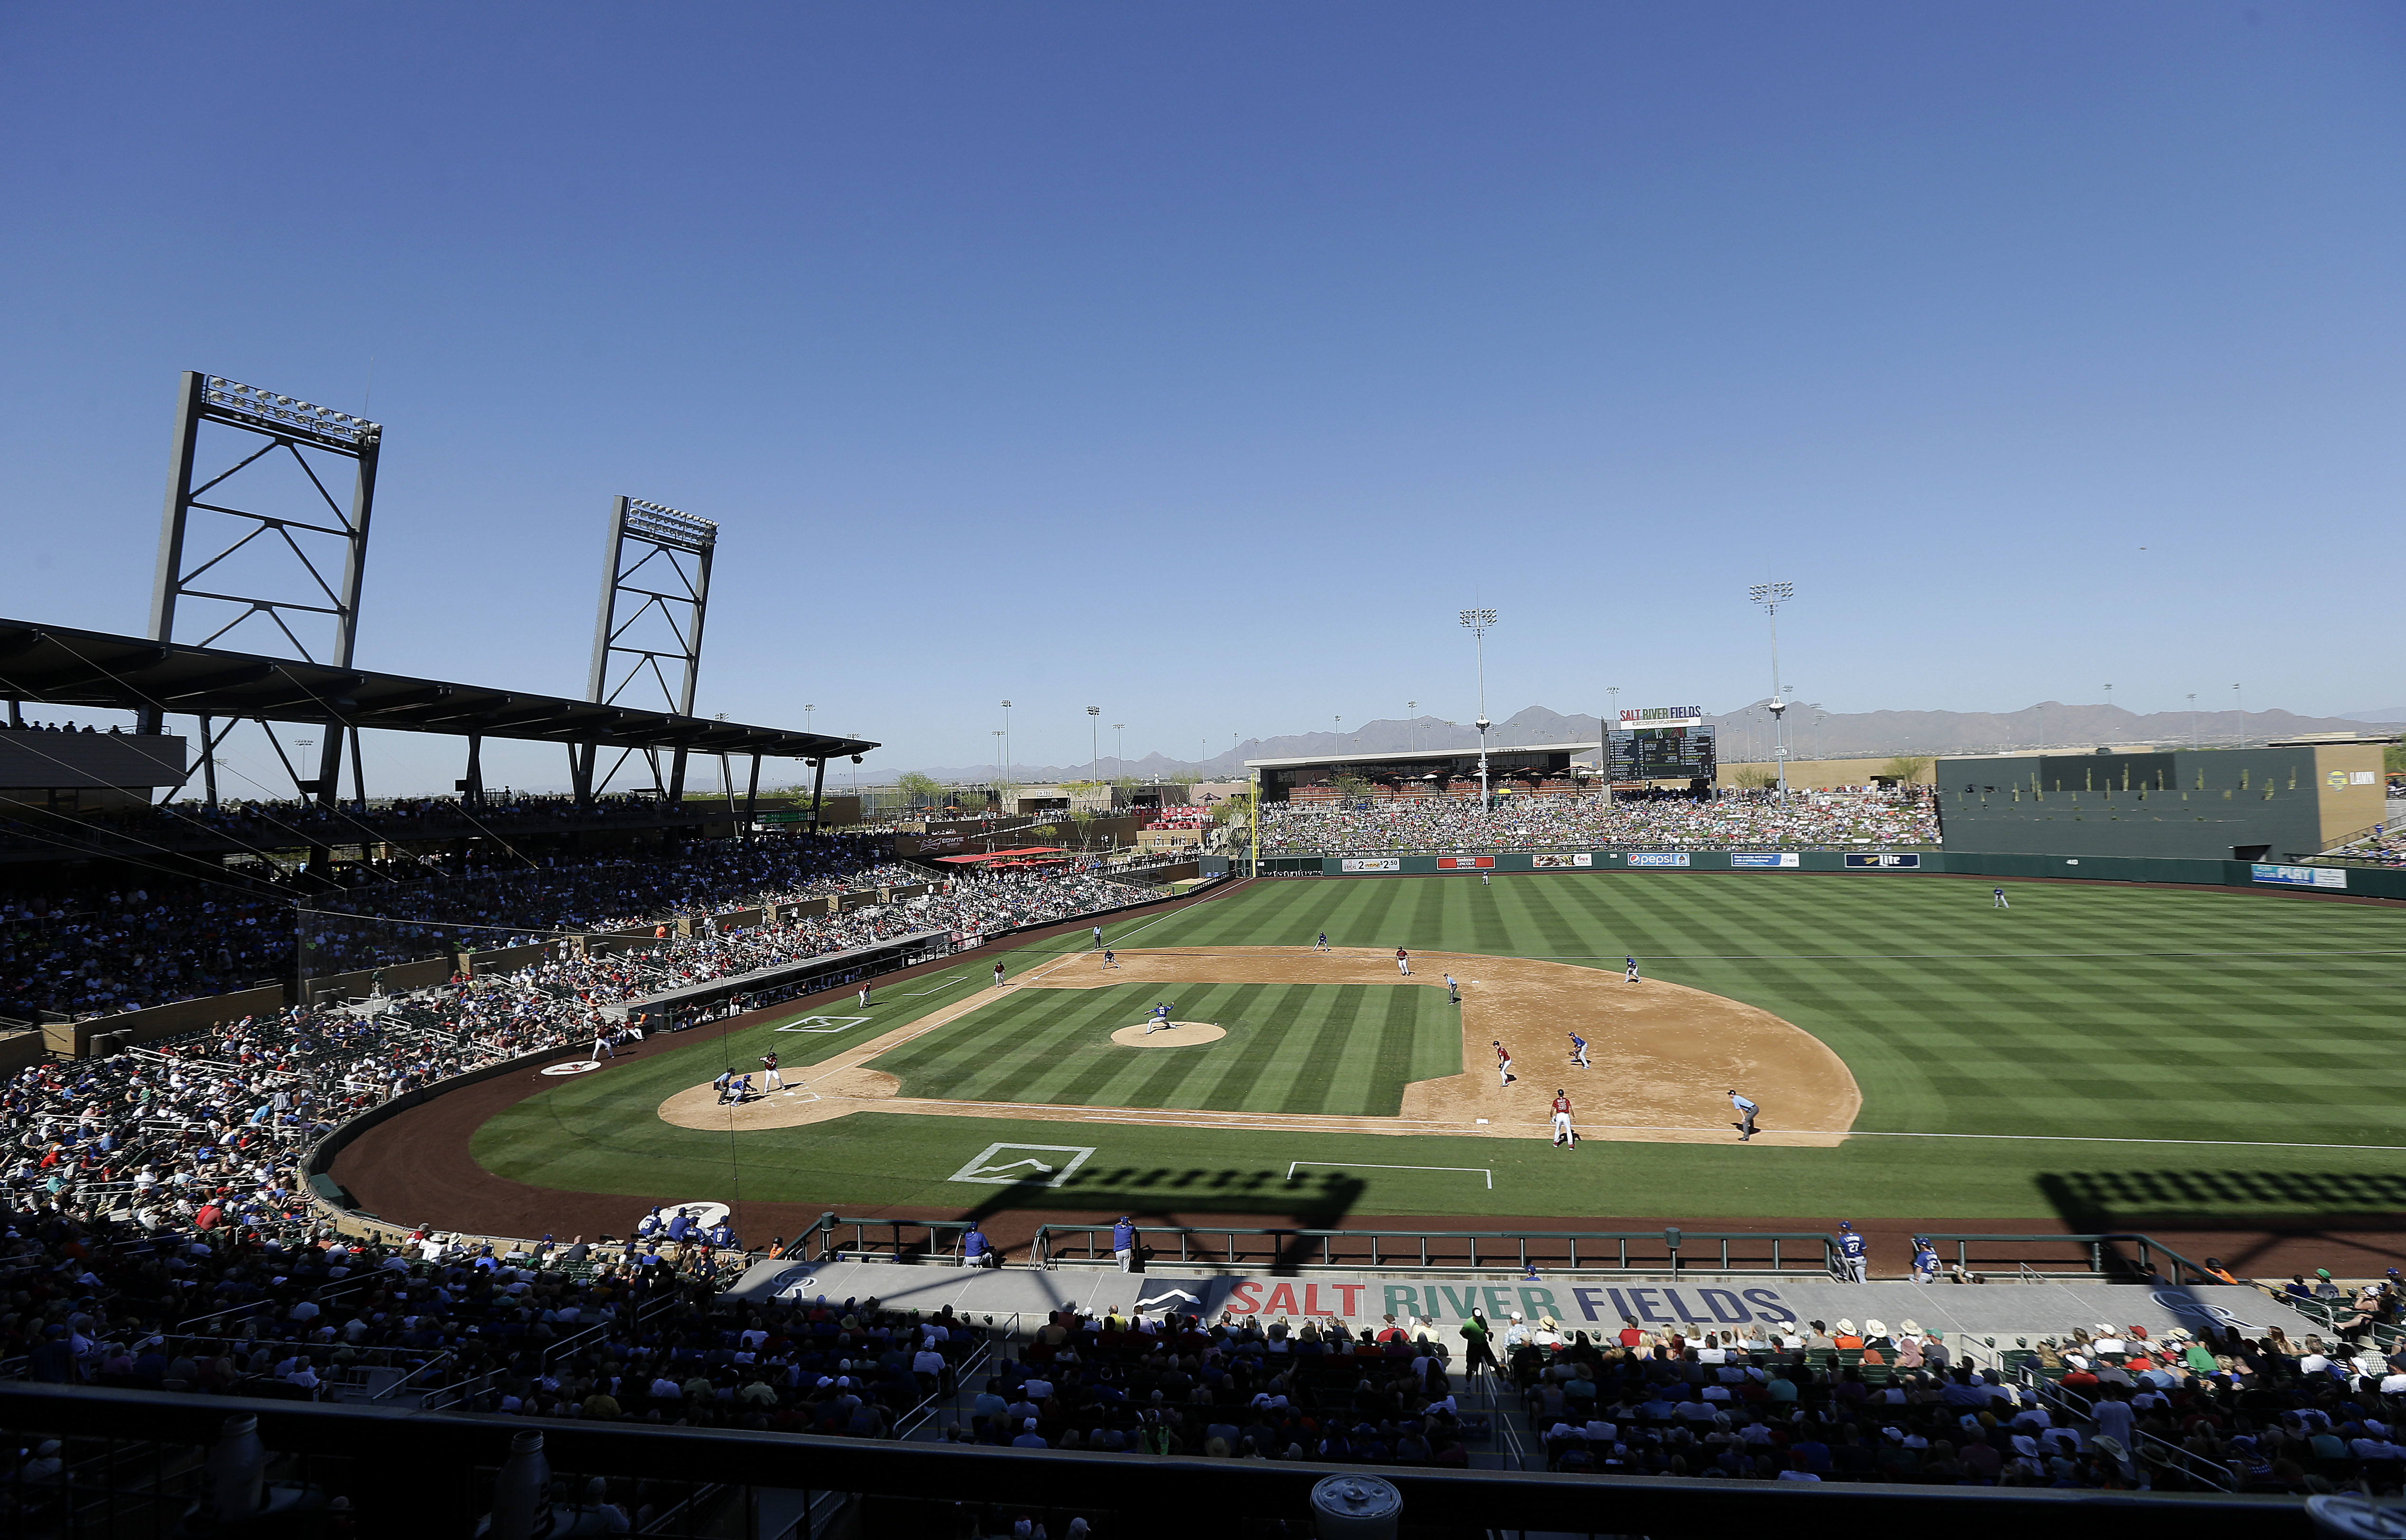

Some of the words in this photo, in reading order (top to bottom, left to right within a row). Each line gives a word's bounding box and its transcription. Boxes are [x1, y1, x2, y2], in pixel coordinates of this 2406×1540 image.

[1620, 709, 1641, 721] SALT
[1643, 708, 1668, 720] RIVER
[1671, 706, 1701, 718] FIELDS
[1655, 729, 1663, 739] VS
[2350, 771, 2375, 785] LAWN
[1359, 861, 1364, 869] 2
[1380, 861, 1397, 869] $2.50
[1641, 854, 1674, 865] pepsi
[1879, 855, 1901, 866] Lite
[2277, 867, 2312, 880] PLAY
[717, 1233, 723, 1242] 8
[1847, 1242, 1859, 1252] 27
[1226, 1281, 1366, 1317] SALT
[1383, 1285, 1566, 1321] RIVER
[1572, 1288, 1797, 1324] FIELDS
